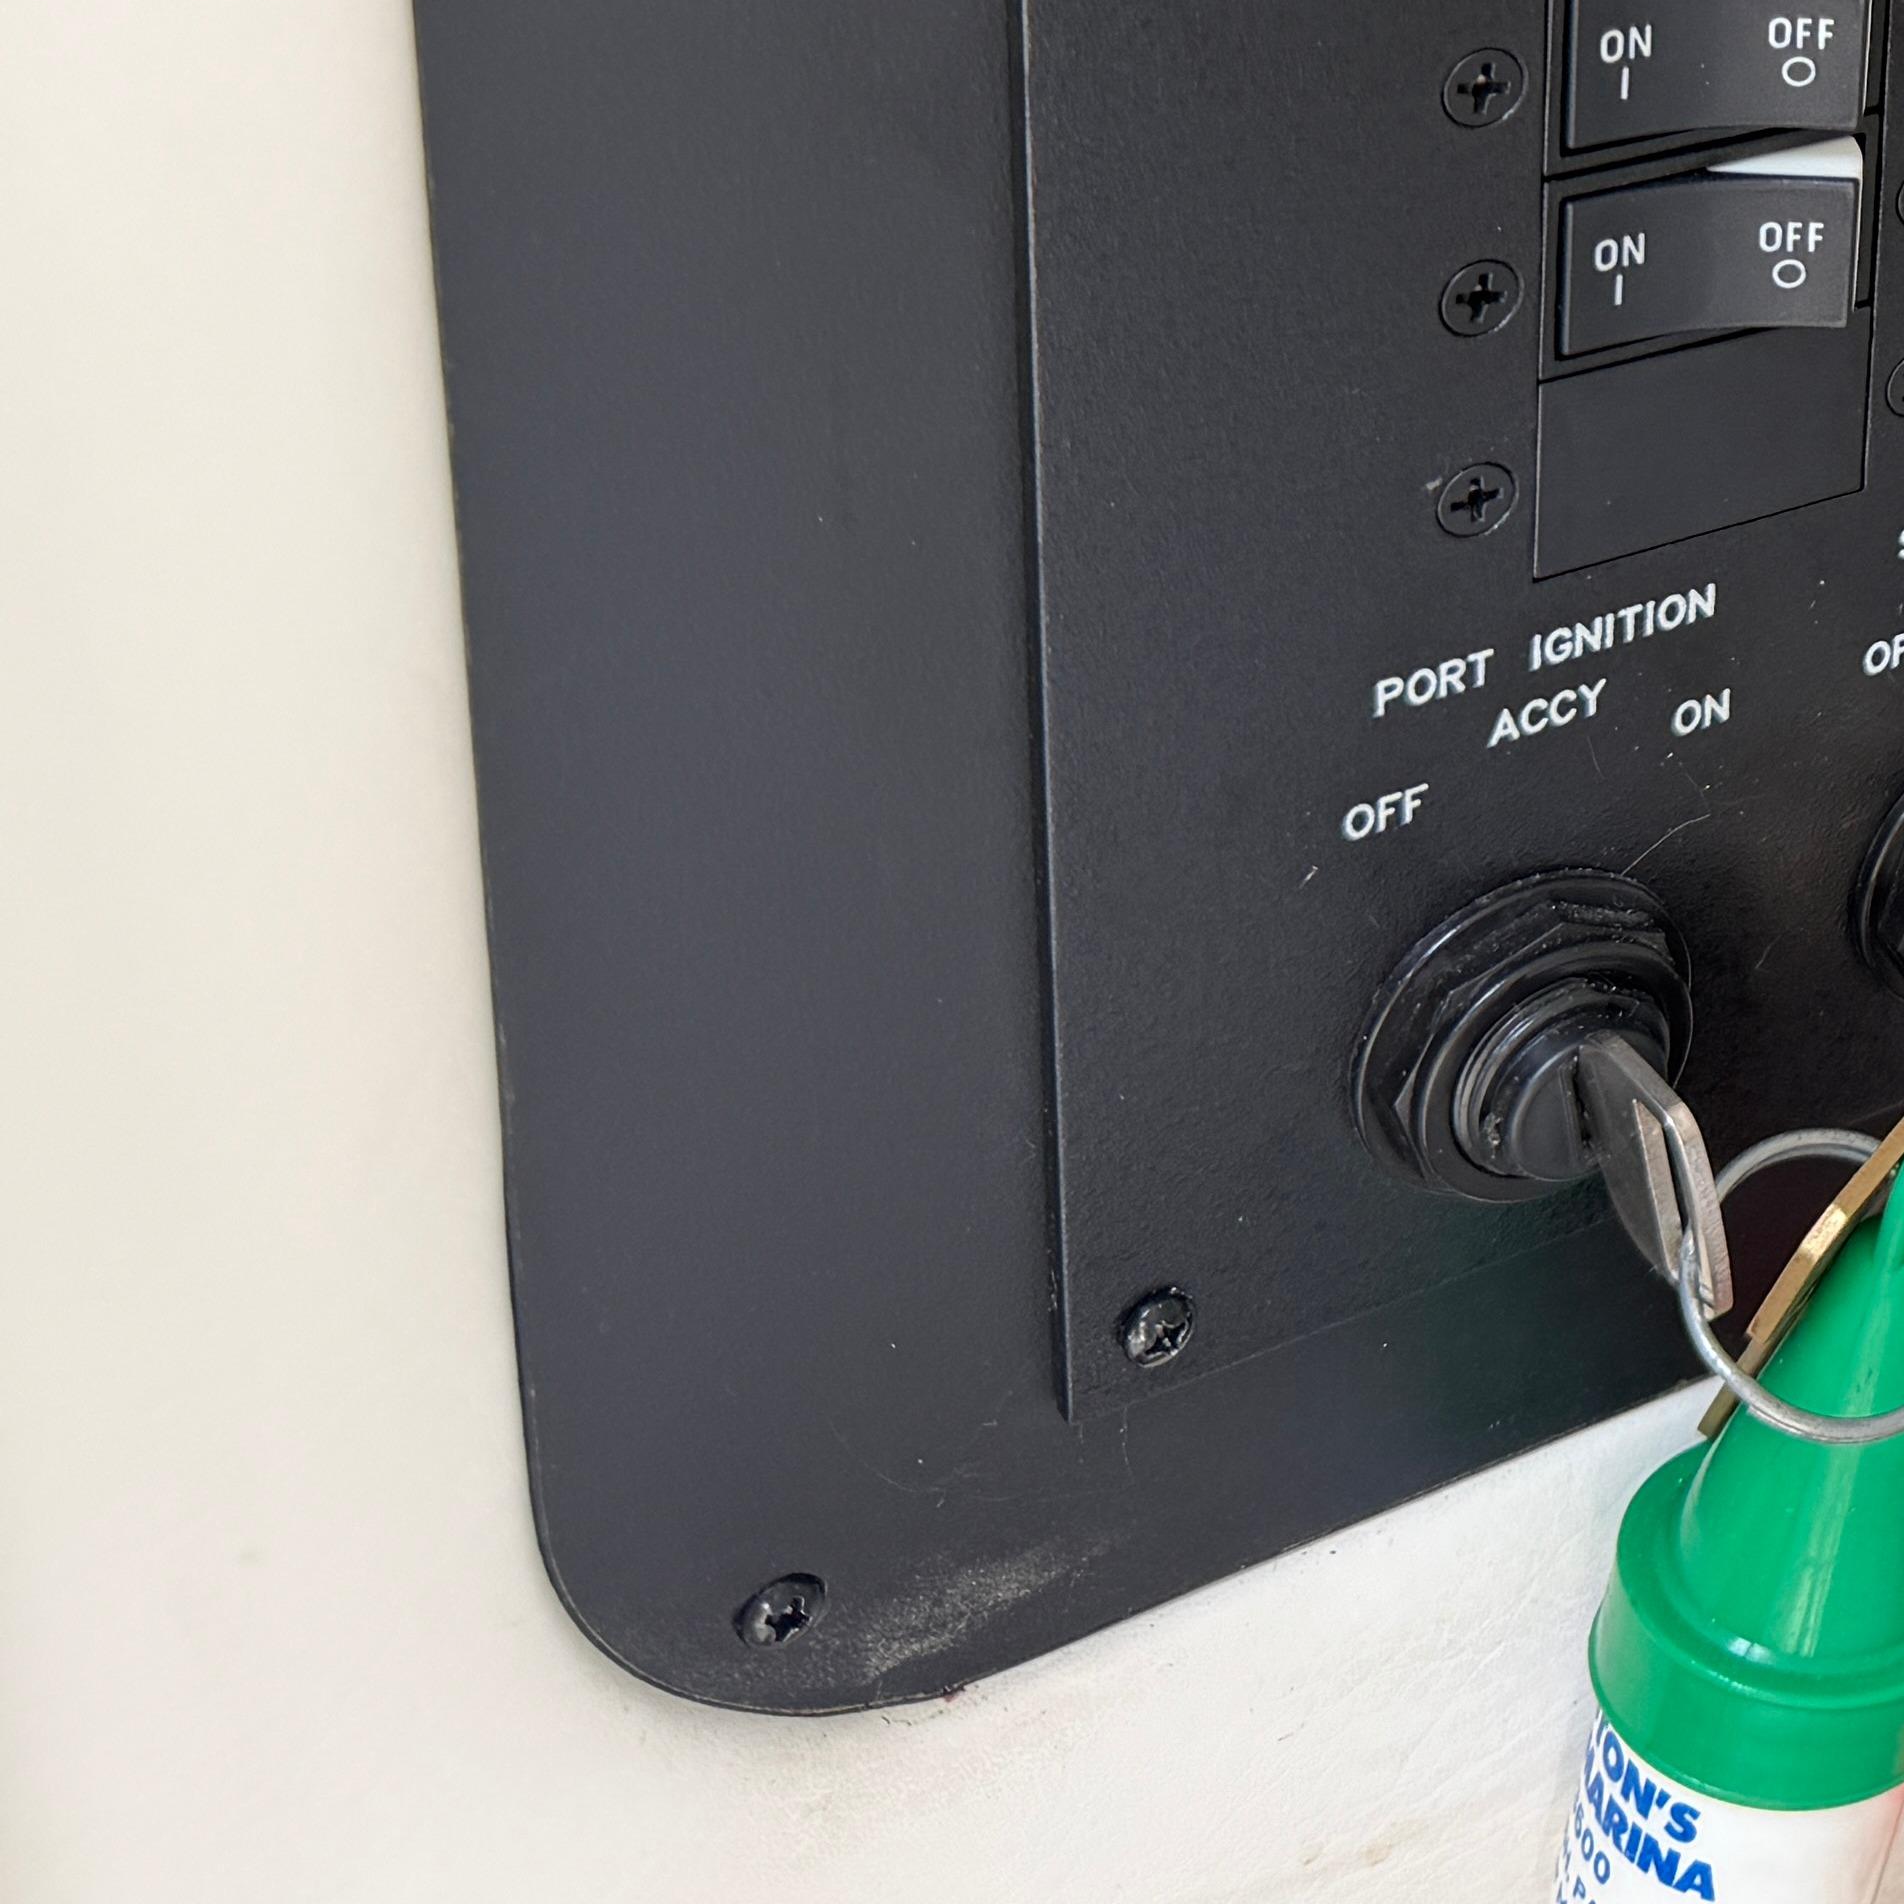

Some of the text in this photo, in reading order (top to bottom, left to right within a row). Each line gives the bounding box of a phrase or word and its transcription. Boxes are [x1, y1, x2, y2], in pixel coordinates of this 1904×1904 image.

[1600, 24, 1652, 64] ON
[1768, 16, 1835, 50] OFF
[1594, 232, 1645, 272] ON
[1759, 221, 1825, 253] OFF
[1374, 582, 1716, 717] PORT IGNITION
[1486, 678, 1608, 748] ACCY
[1673, 688, 1731, 736] ON
[1342, 783, 1429, 841] OFF
